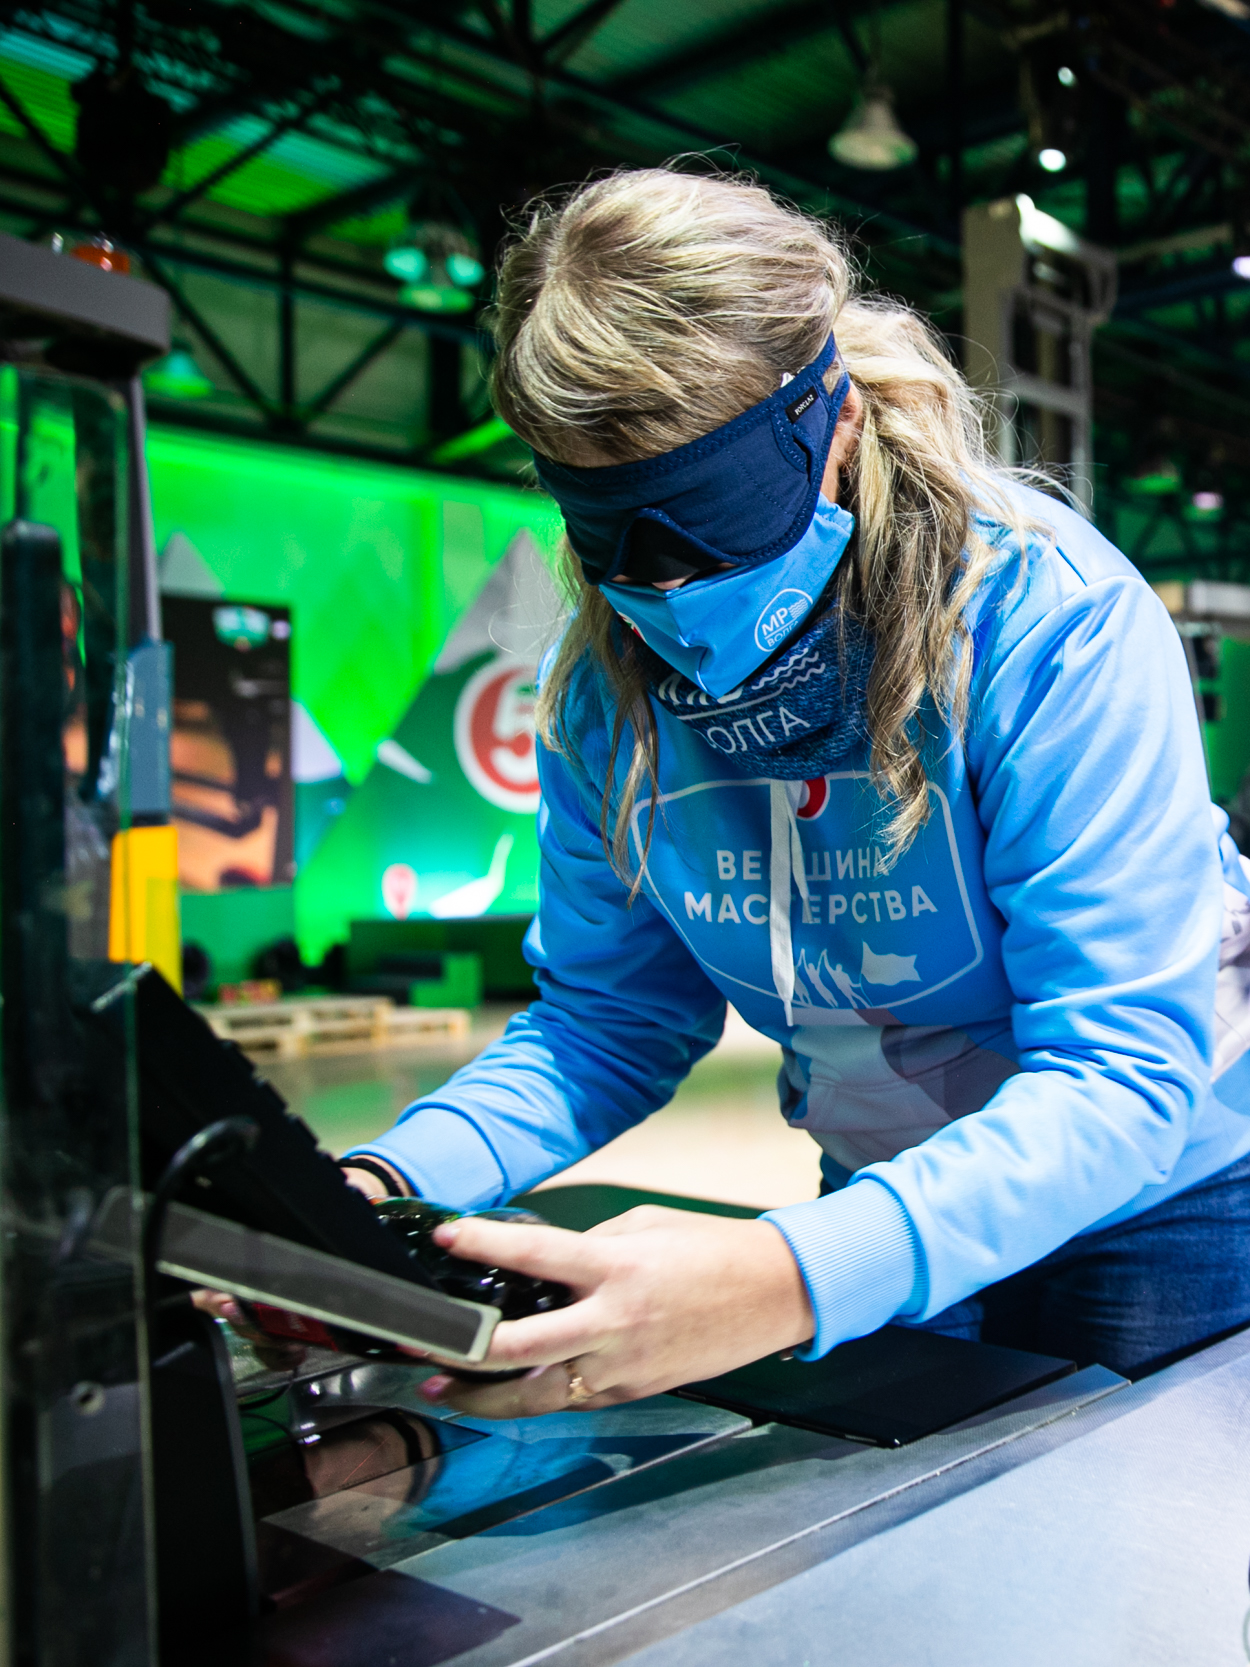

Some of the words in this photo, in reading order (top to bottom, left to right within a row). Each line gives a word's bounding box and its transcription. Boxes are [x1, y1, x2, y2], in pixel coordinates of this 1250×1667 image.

[694, 706, 811, 754] ОЛГА
[716, 845, 890, 882] ВЕШИНА
[684, 884, 939, 925] МАСЕРСТВА
